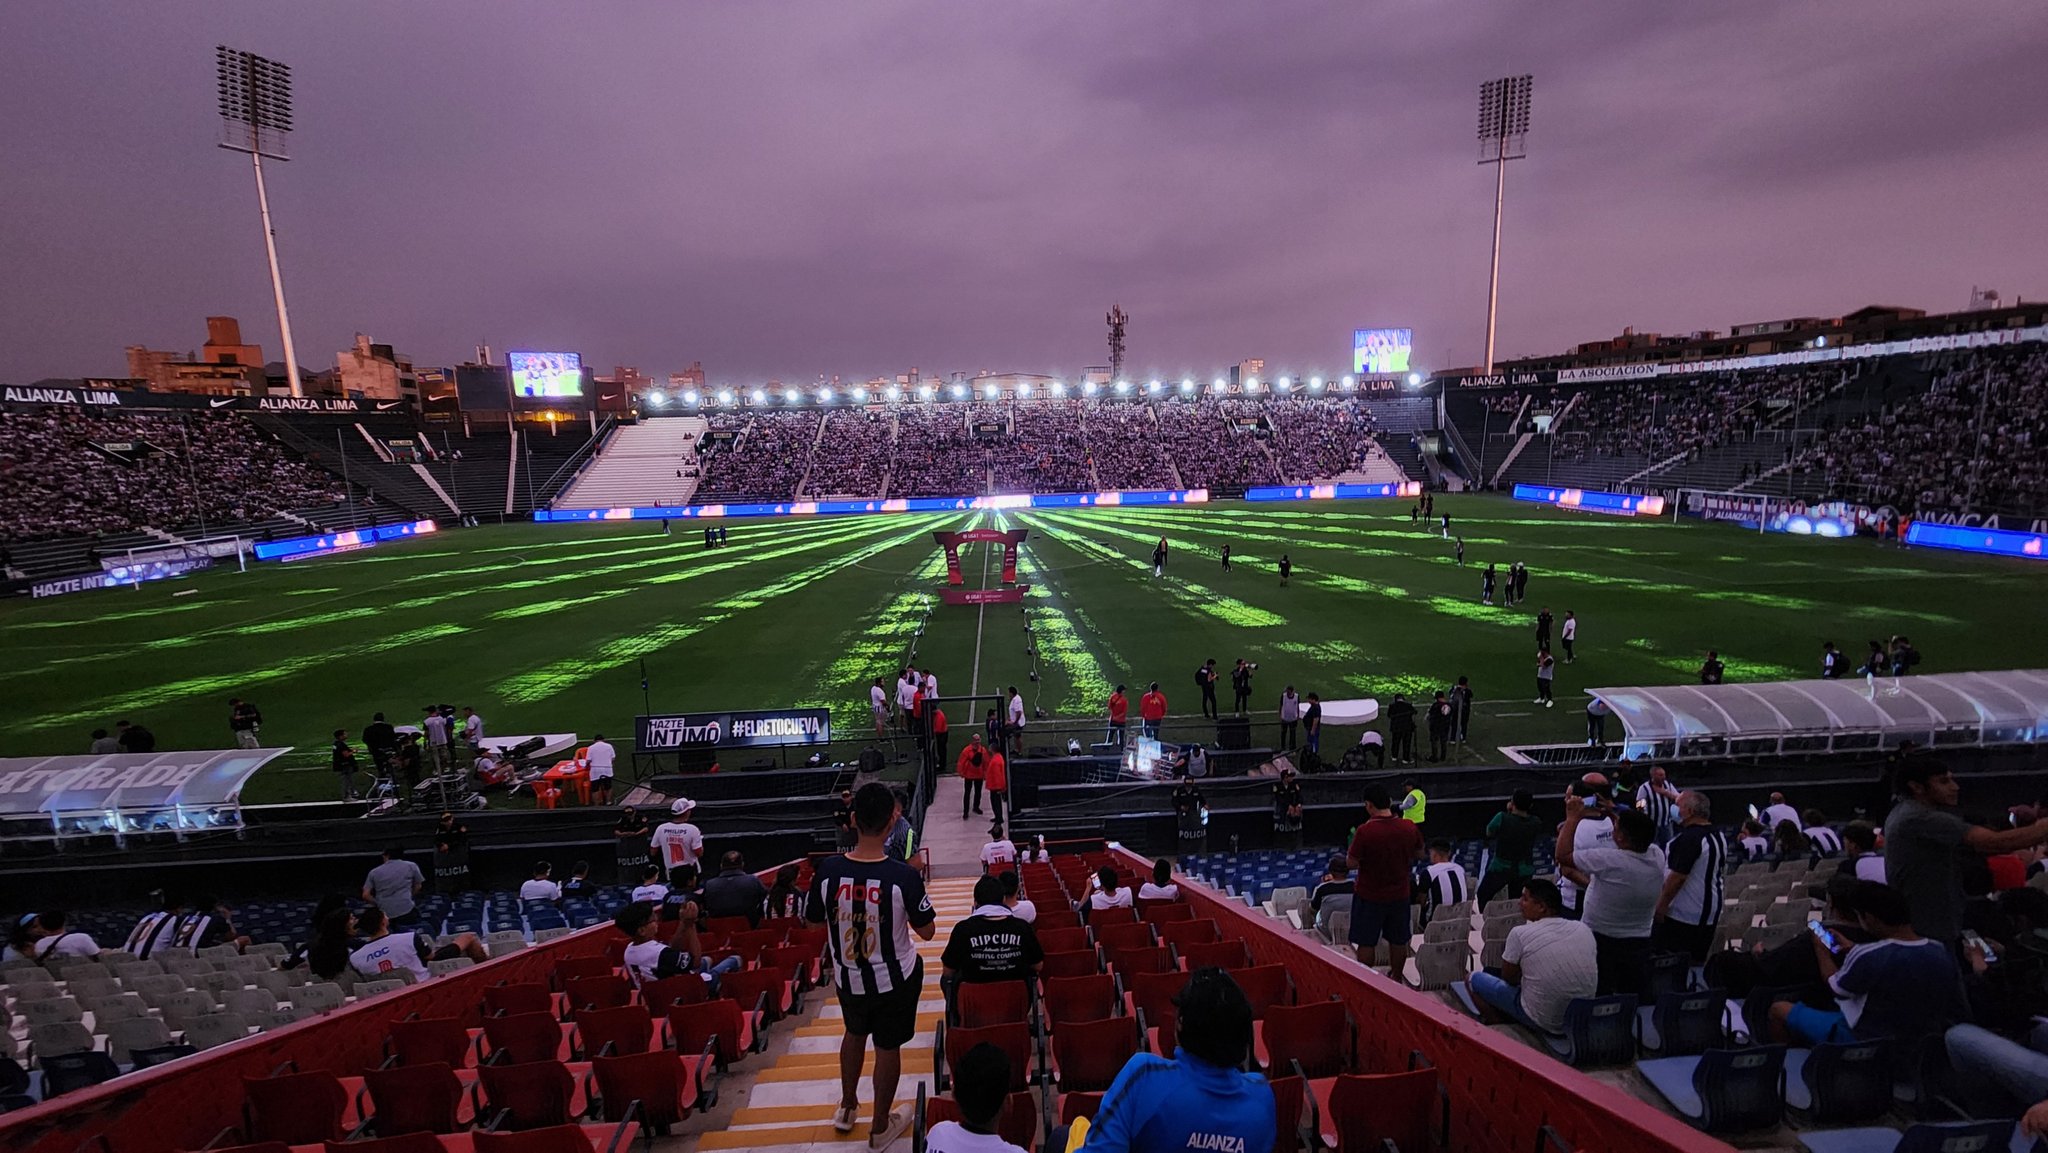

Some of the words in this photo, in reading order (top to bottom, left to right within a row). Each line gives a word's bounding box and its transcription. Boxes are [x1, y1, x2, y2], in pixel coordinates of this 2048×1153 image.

[1459, 375, 1507, 388] ALIANZA
[1511, 373, 1539, 385] LIMA
[1560, 370, 1577, 380] LA
[1371, 381, 1396, 391] LIMA
[4, 387, 78, 404] ALIANZA
[83, 390, 121, 406] LIMA
[868, 392, 910, 403] ALIAZA
[913, 392, 937, 402] LIA
[259, 398, 320, 411] ALIANZA
[324, 399, 359, 411] LIMA
[1714, 510, 1763, 523] ALIANZAPLA
[32, 578, 81, 599] HAZTE
[81, 574, 106, 590] INT
[650, 719, 684, 729] HAZTE
[732, 716, 821, 738] #ELRETOCUEVA
[834, 884, 883, 905] AOC
[844, 926, 877, 961] 20
[969, 933, 1022, 948] RIPCURL
[366, 946, 390, 962] AOC
[1186, 1132, 1246, 1153] ALIANZA
